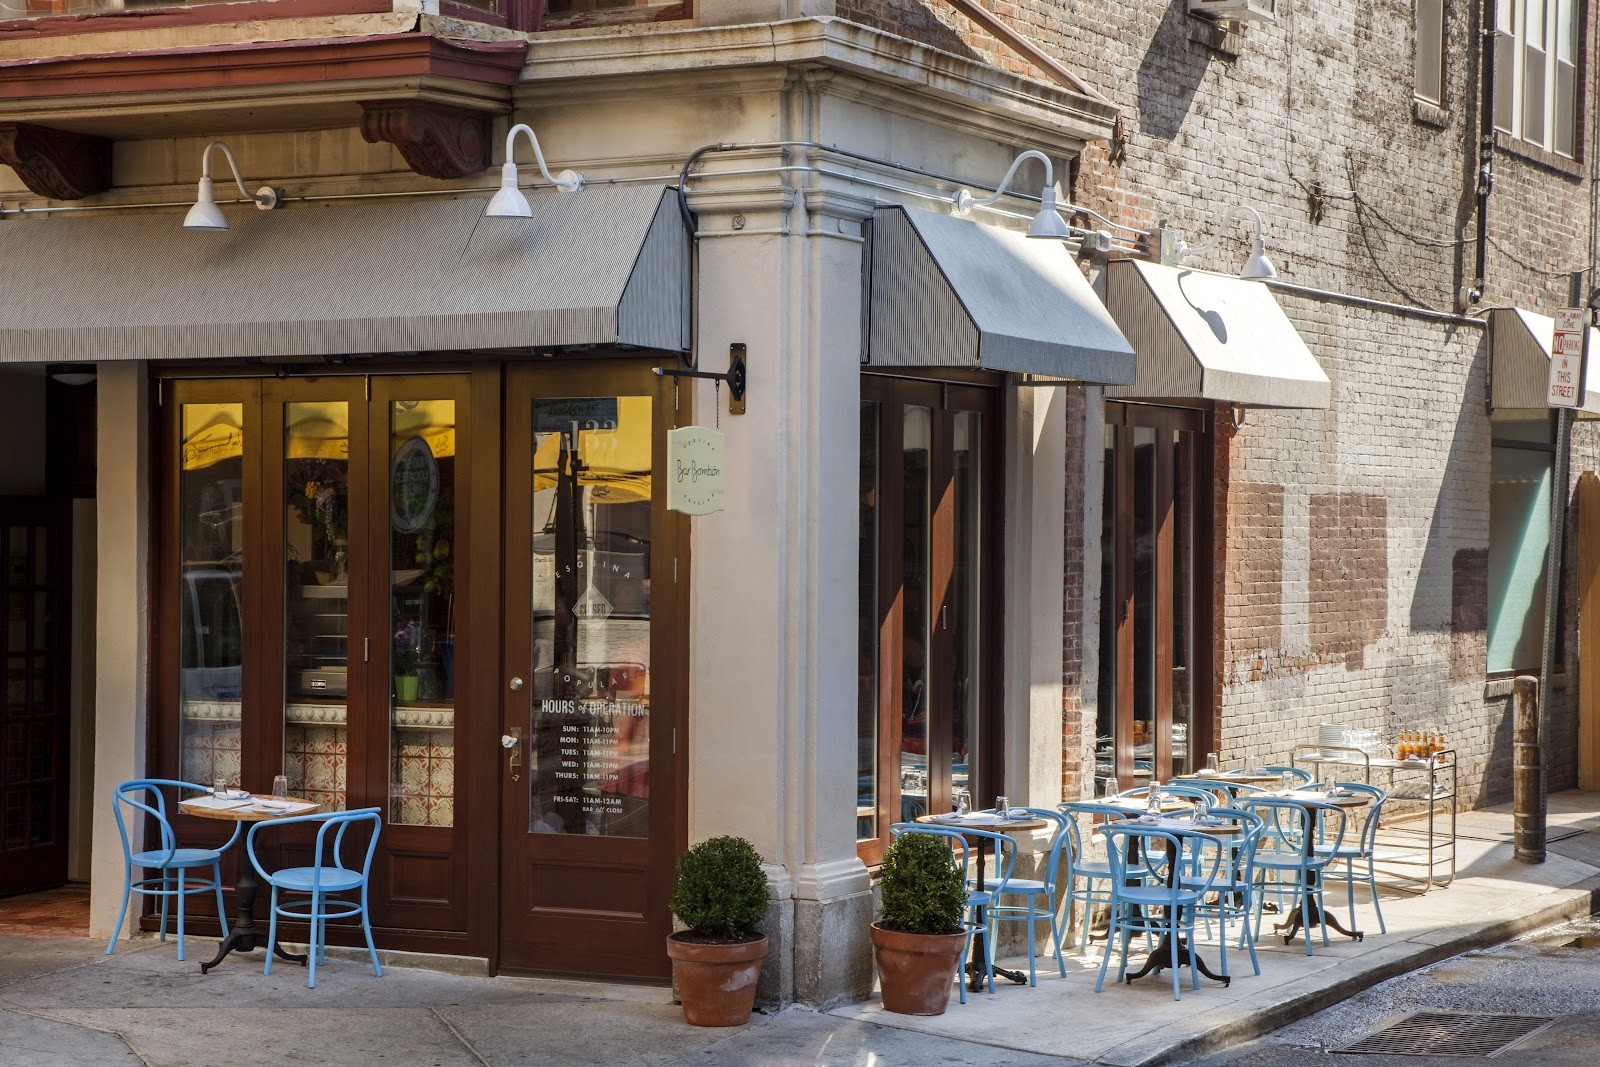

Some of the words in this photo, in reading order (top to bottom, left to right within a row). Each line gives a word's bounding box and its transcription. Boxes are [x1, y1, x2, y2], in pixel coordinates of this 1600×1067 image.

[1553, 335, 1564, 352] NO
[1562, 359, 1569, 368] IN
[1557, 371, 1571, 383] THIS
[1551, 385, 1575, 398] STREET
[677, 459, 691, 483] Bar
[554, 668, 629, 689] POPULAR
[541, 700, 575, 714] HOURS
[589, 701, 646, 717] OPERATION
[583, 726, 620, 734] 11AM-10PM
[583, 797, 622, 805] 11AM-12AM
